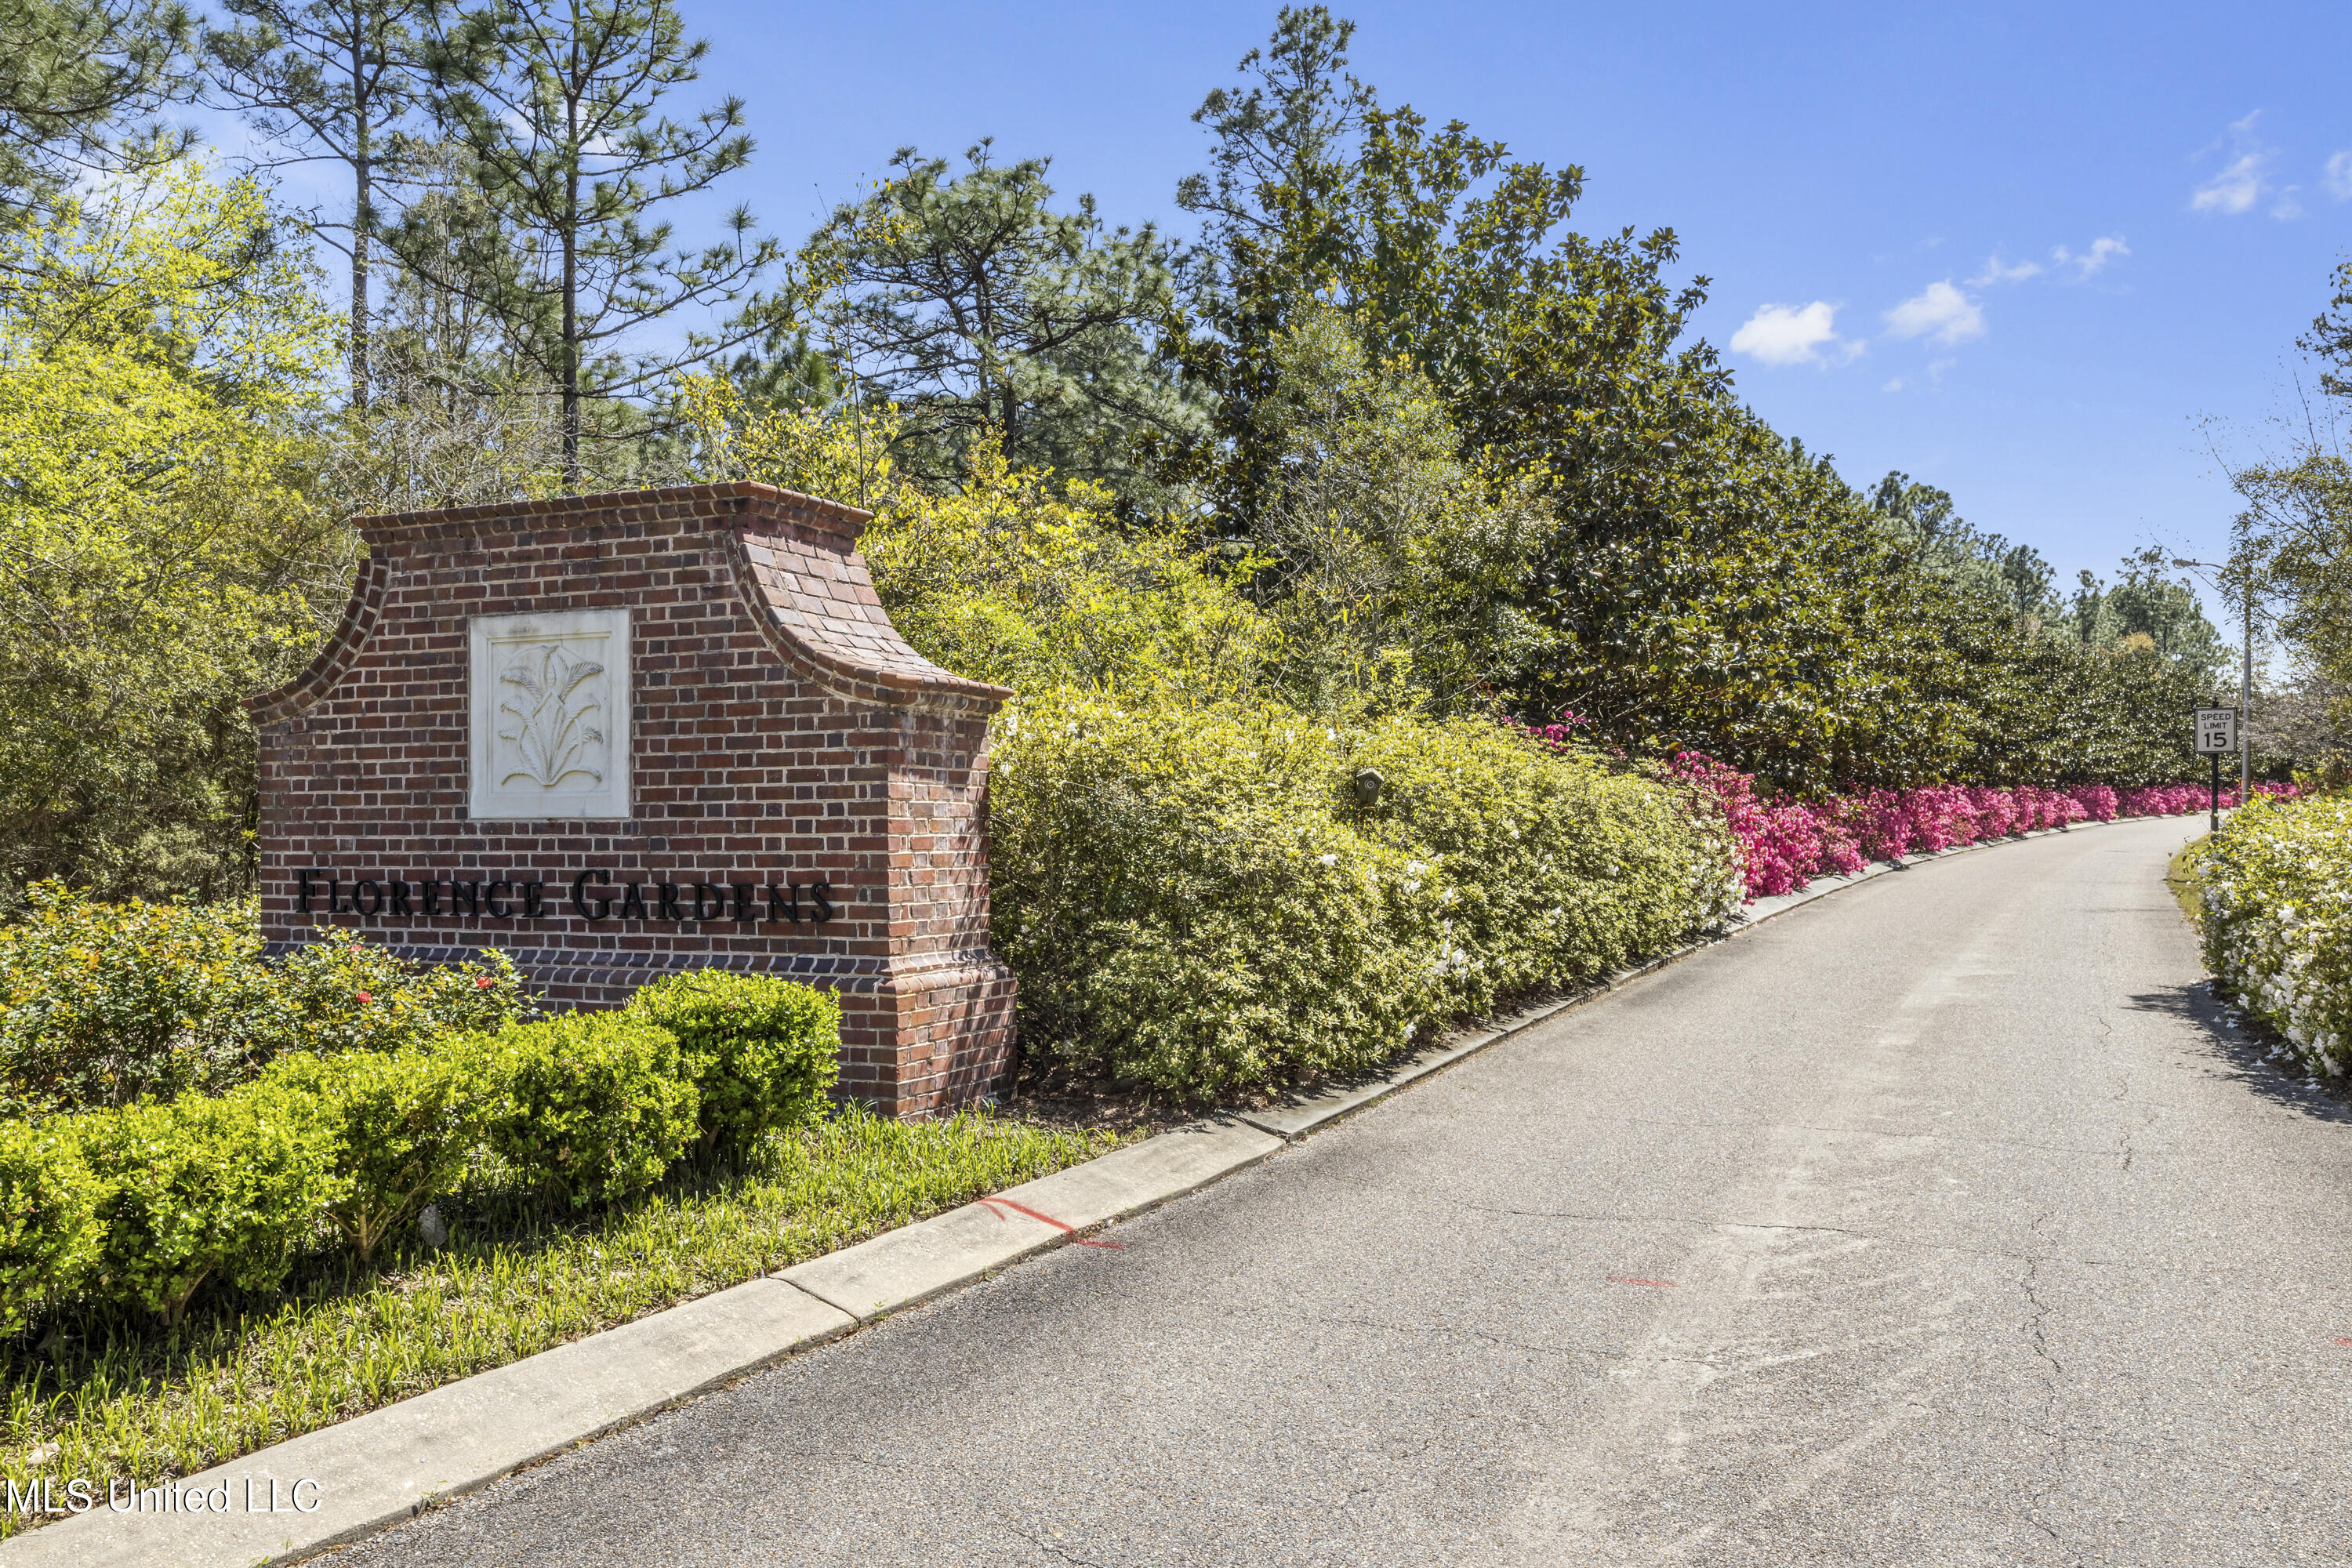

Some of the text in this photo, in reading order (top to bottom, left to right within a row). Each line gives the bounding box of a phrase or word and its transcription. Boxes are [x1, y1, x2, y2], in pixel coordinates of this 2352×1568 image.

[2204, 732, 2227, 748] 15
[296, 867, 833, 923] FLORENCE GARDENS
